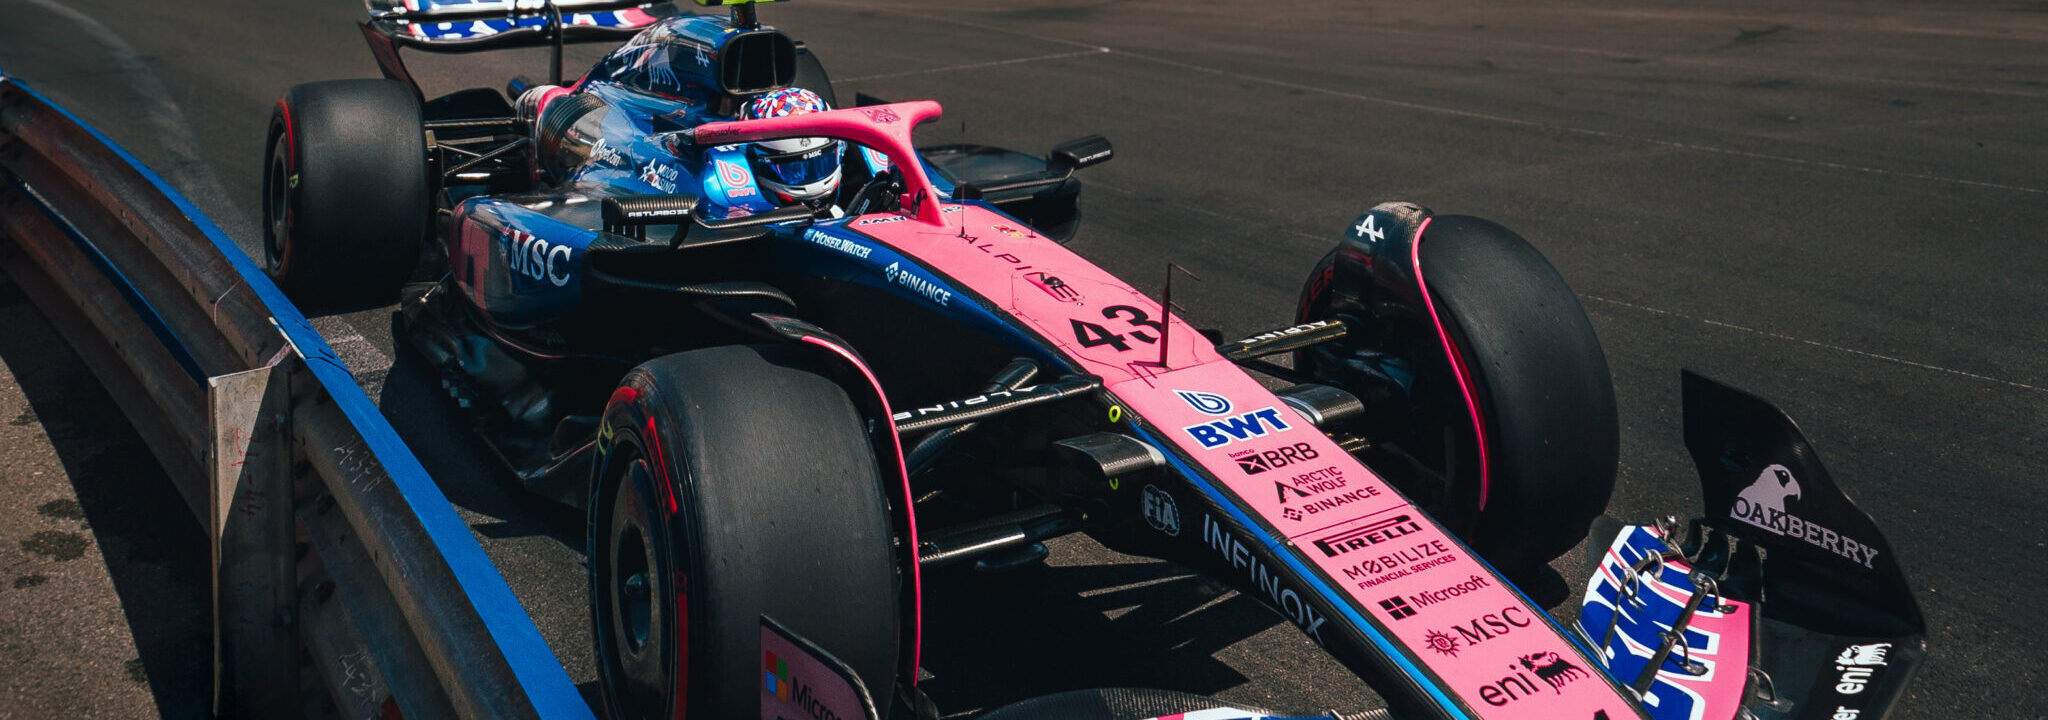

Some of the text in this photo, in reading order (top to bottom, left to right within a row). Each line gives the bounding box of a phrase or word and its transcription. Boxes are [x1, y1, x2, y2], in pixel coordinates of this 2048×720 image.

[510, 229, 572, 287] MSC
[899, 269, 951, 307] BINANCE
[1069, 304, 1163, 353] 43
[1185, 407, 1290, 449] BWT
[1228, 448, 1255, 459] banco
[1266, 442, 1319, 469] BRB
[1291, 466, 1343, 486] ARCTIC
[1306, 477, 1347, 495] WOLF
[1143, 490, 1178, 530] FIA
[1304, 485, 1382, 515] BINANCE
[1311, 514, 1424, 558] PIRELLI
[1732, 496, 1879, 569] OAKBERRY
[1204, 513, 1327, 647] INFINOX
[1358, 554, 1457, 591] FINANCIAL SERVICES
[1409, 574, 1490, 610] Microsoft
[1451, 606, 1532, 647] MSC
[1478, 665, 1541, 707] eni
[1835, 666, 1874, 694] eni
